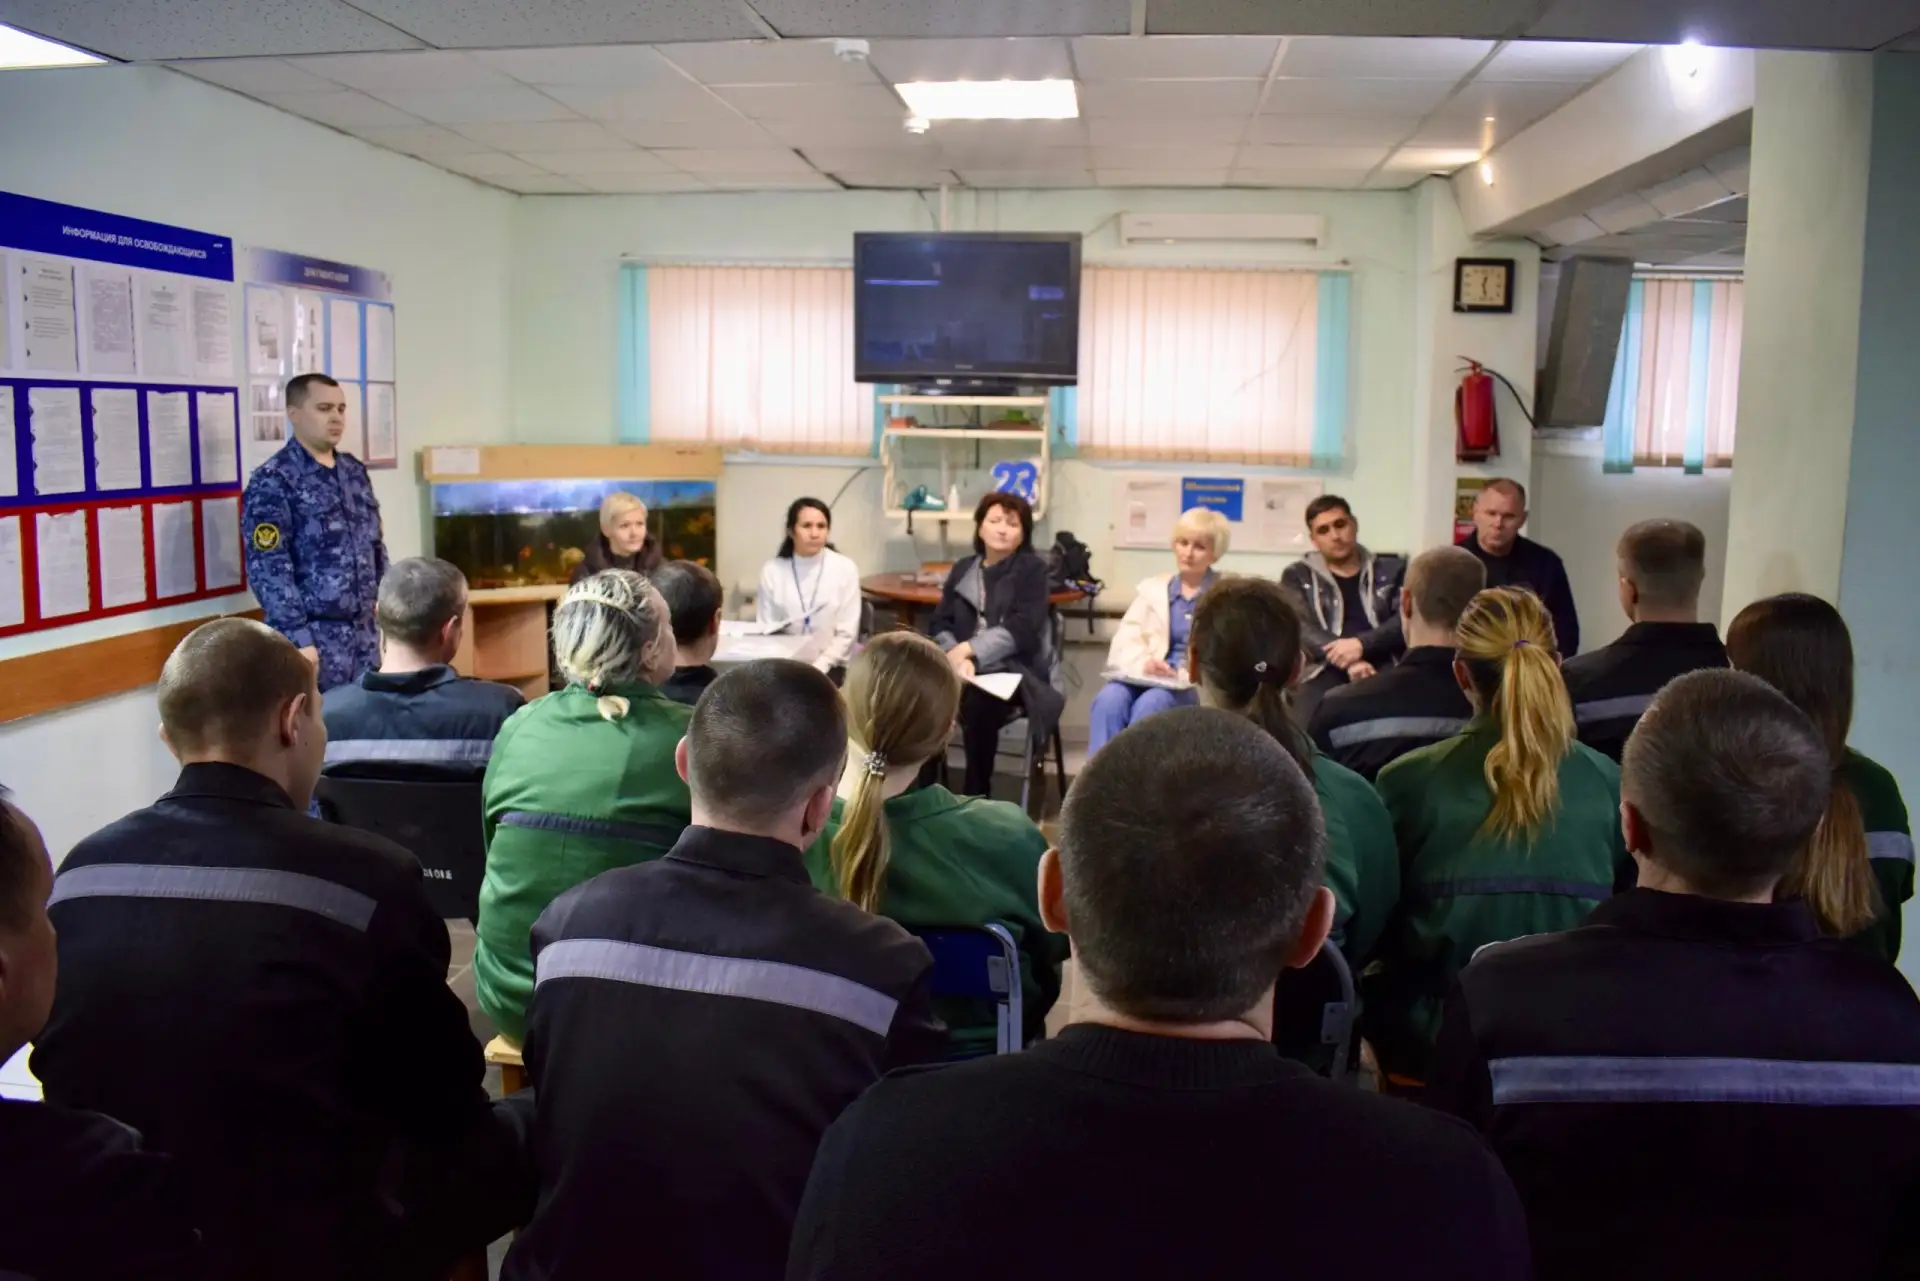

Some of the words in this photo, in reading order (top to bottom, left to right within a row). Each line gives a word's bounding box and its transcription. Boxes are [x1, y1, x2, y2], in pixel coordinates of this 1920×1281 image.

[62, 225, 117, 244] ИНФОРМАЦИЯ
[118, 235, 133, 247] ДЛЯ
[134, 238, 207, 259] ОСВОБОЖДАЮЩИХСЯ
